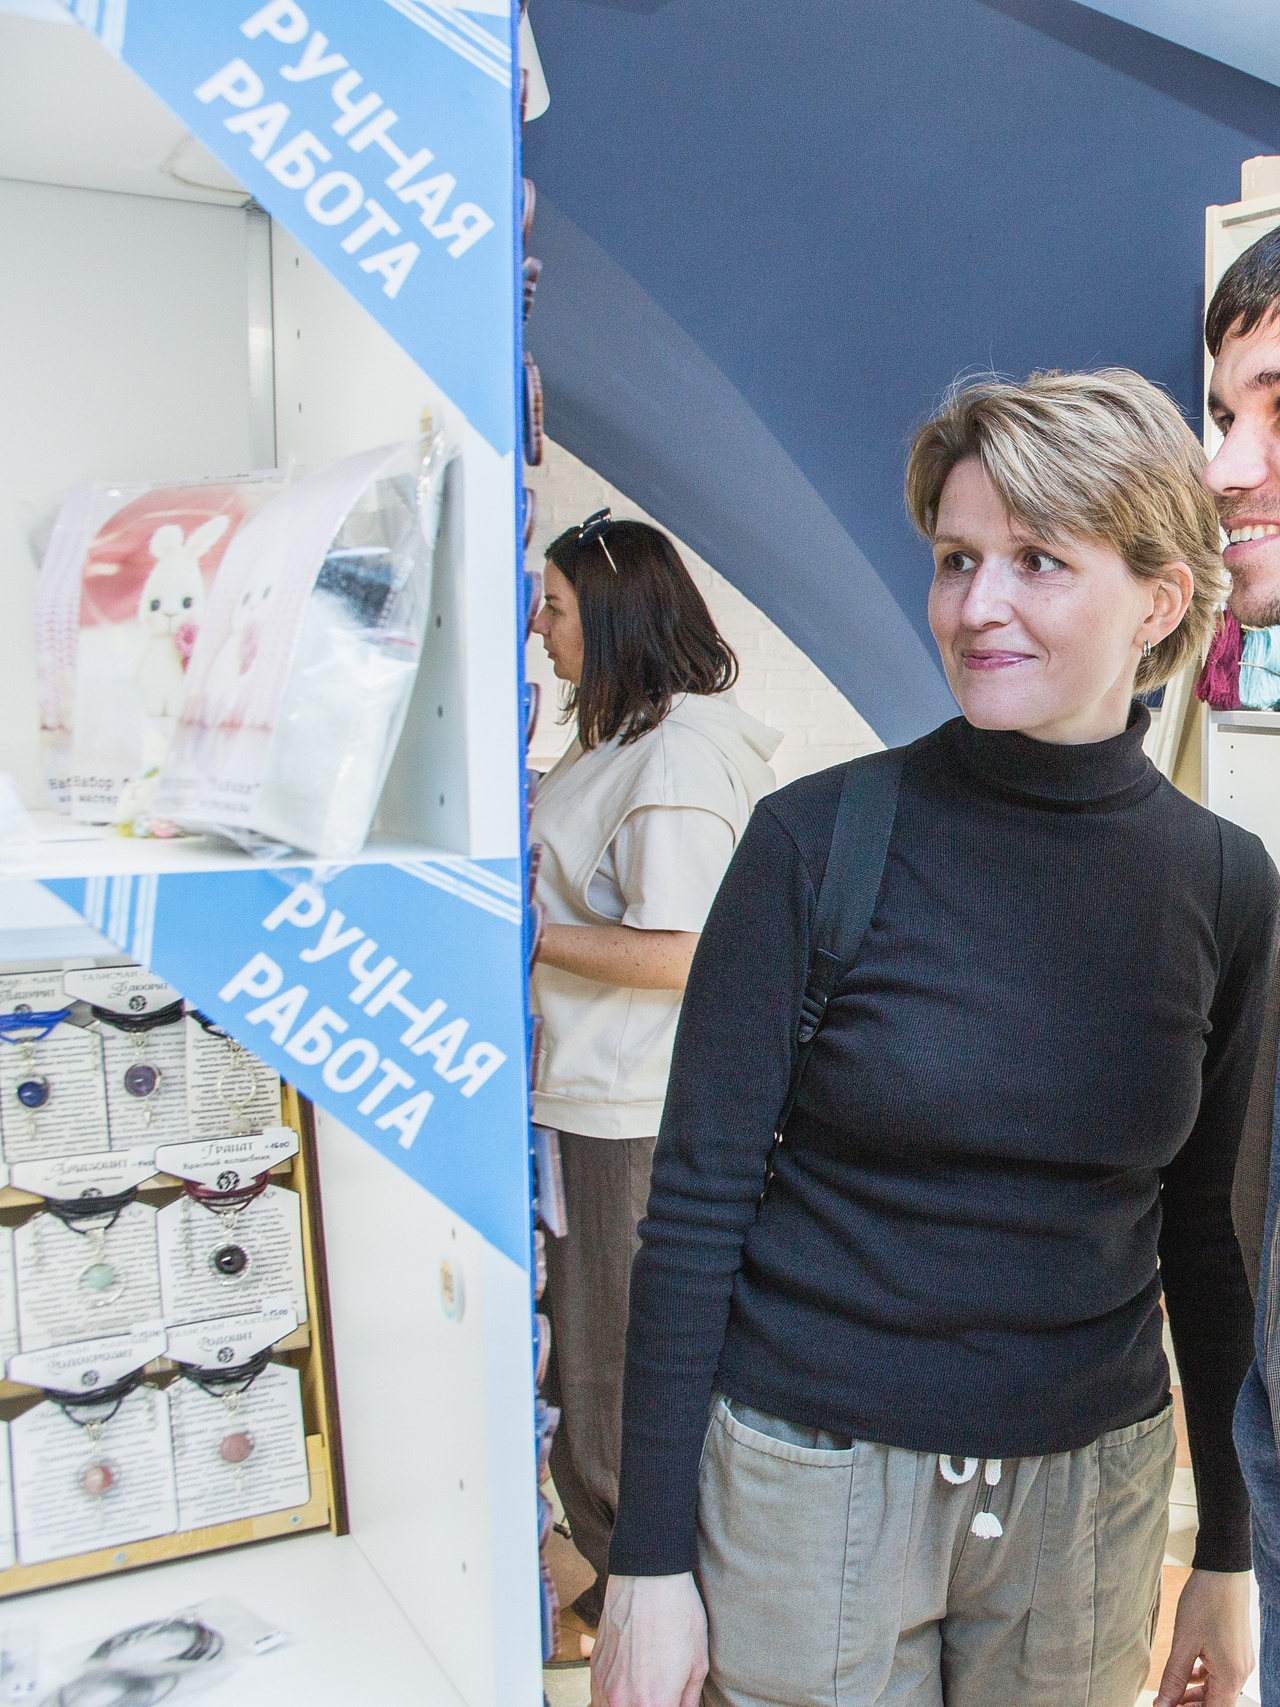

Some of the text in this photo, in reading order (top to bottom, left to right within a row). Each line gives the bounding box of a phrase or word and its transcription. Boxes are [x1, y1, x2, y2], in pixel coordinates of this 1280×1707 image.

[193, 58, 420, 299] РАБОТА
[240, 0, 494, 259] РУЧНАЯ
[218, 952, 435, 1149] РАБОТА
[262, 881, 507, 1098] РУЧНАЯ
